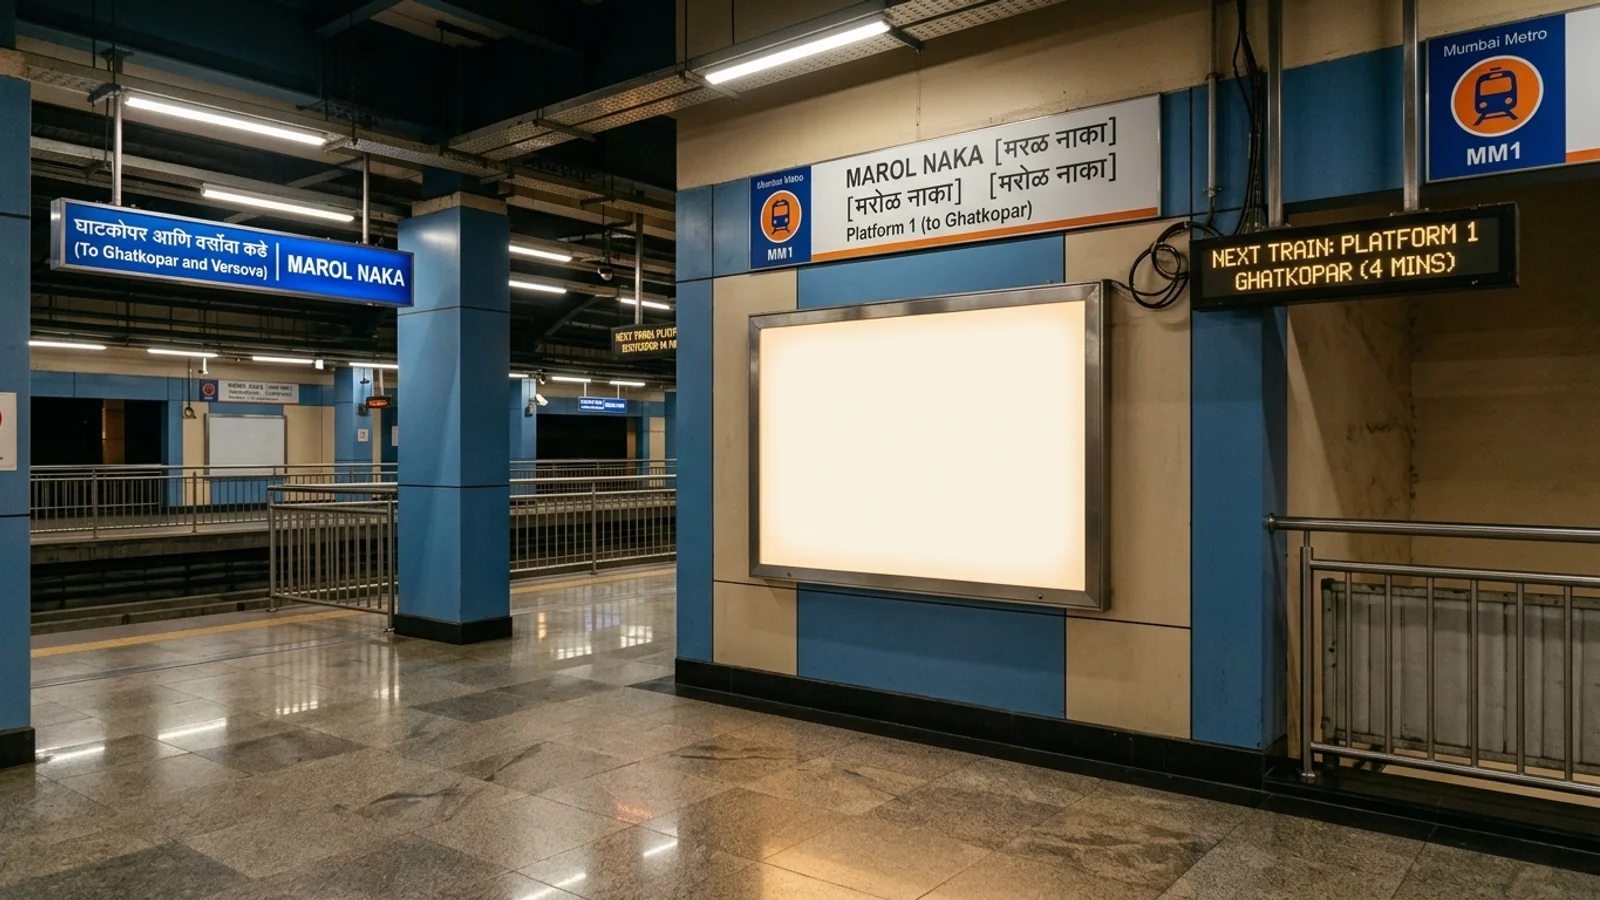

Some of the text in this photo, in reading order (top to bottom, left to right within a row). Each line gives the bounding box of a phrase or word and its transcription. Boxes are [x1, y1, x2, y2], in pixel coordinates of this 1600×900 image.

[1443, 29, 1548, 57] Mumbai Metro
[846, 116, 1117, 189] MAROL NAKA [मरळ नाका]
[1467, 141, 1521, 166] MM1
[847, 152, 1117, 222] [मरोळ नाका] [मरोळ नाका]
[73, 217, 269, 259] घाटकोपर आणि वर्सोवा कडे
[846, 200, 1033, 243] Platform 1 (to Ghatkopar)
[74, 241, 269, 281] (To Ghatkopar and Versova)
[767, 246, 793, 262] MM1
[1212, 221, 1479, 268] NEXT TRAIN: PLATFORM 1
[288, 254, 405, 287] MAROL NAKA
[1236, 252, 1456, 290] GHATKOPAR (4 MINS)
